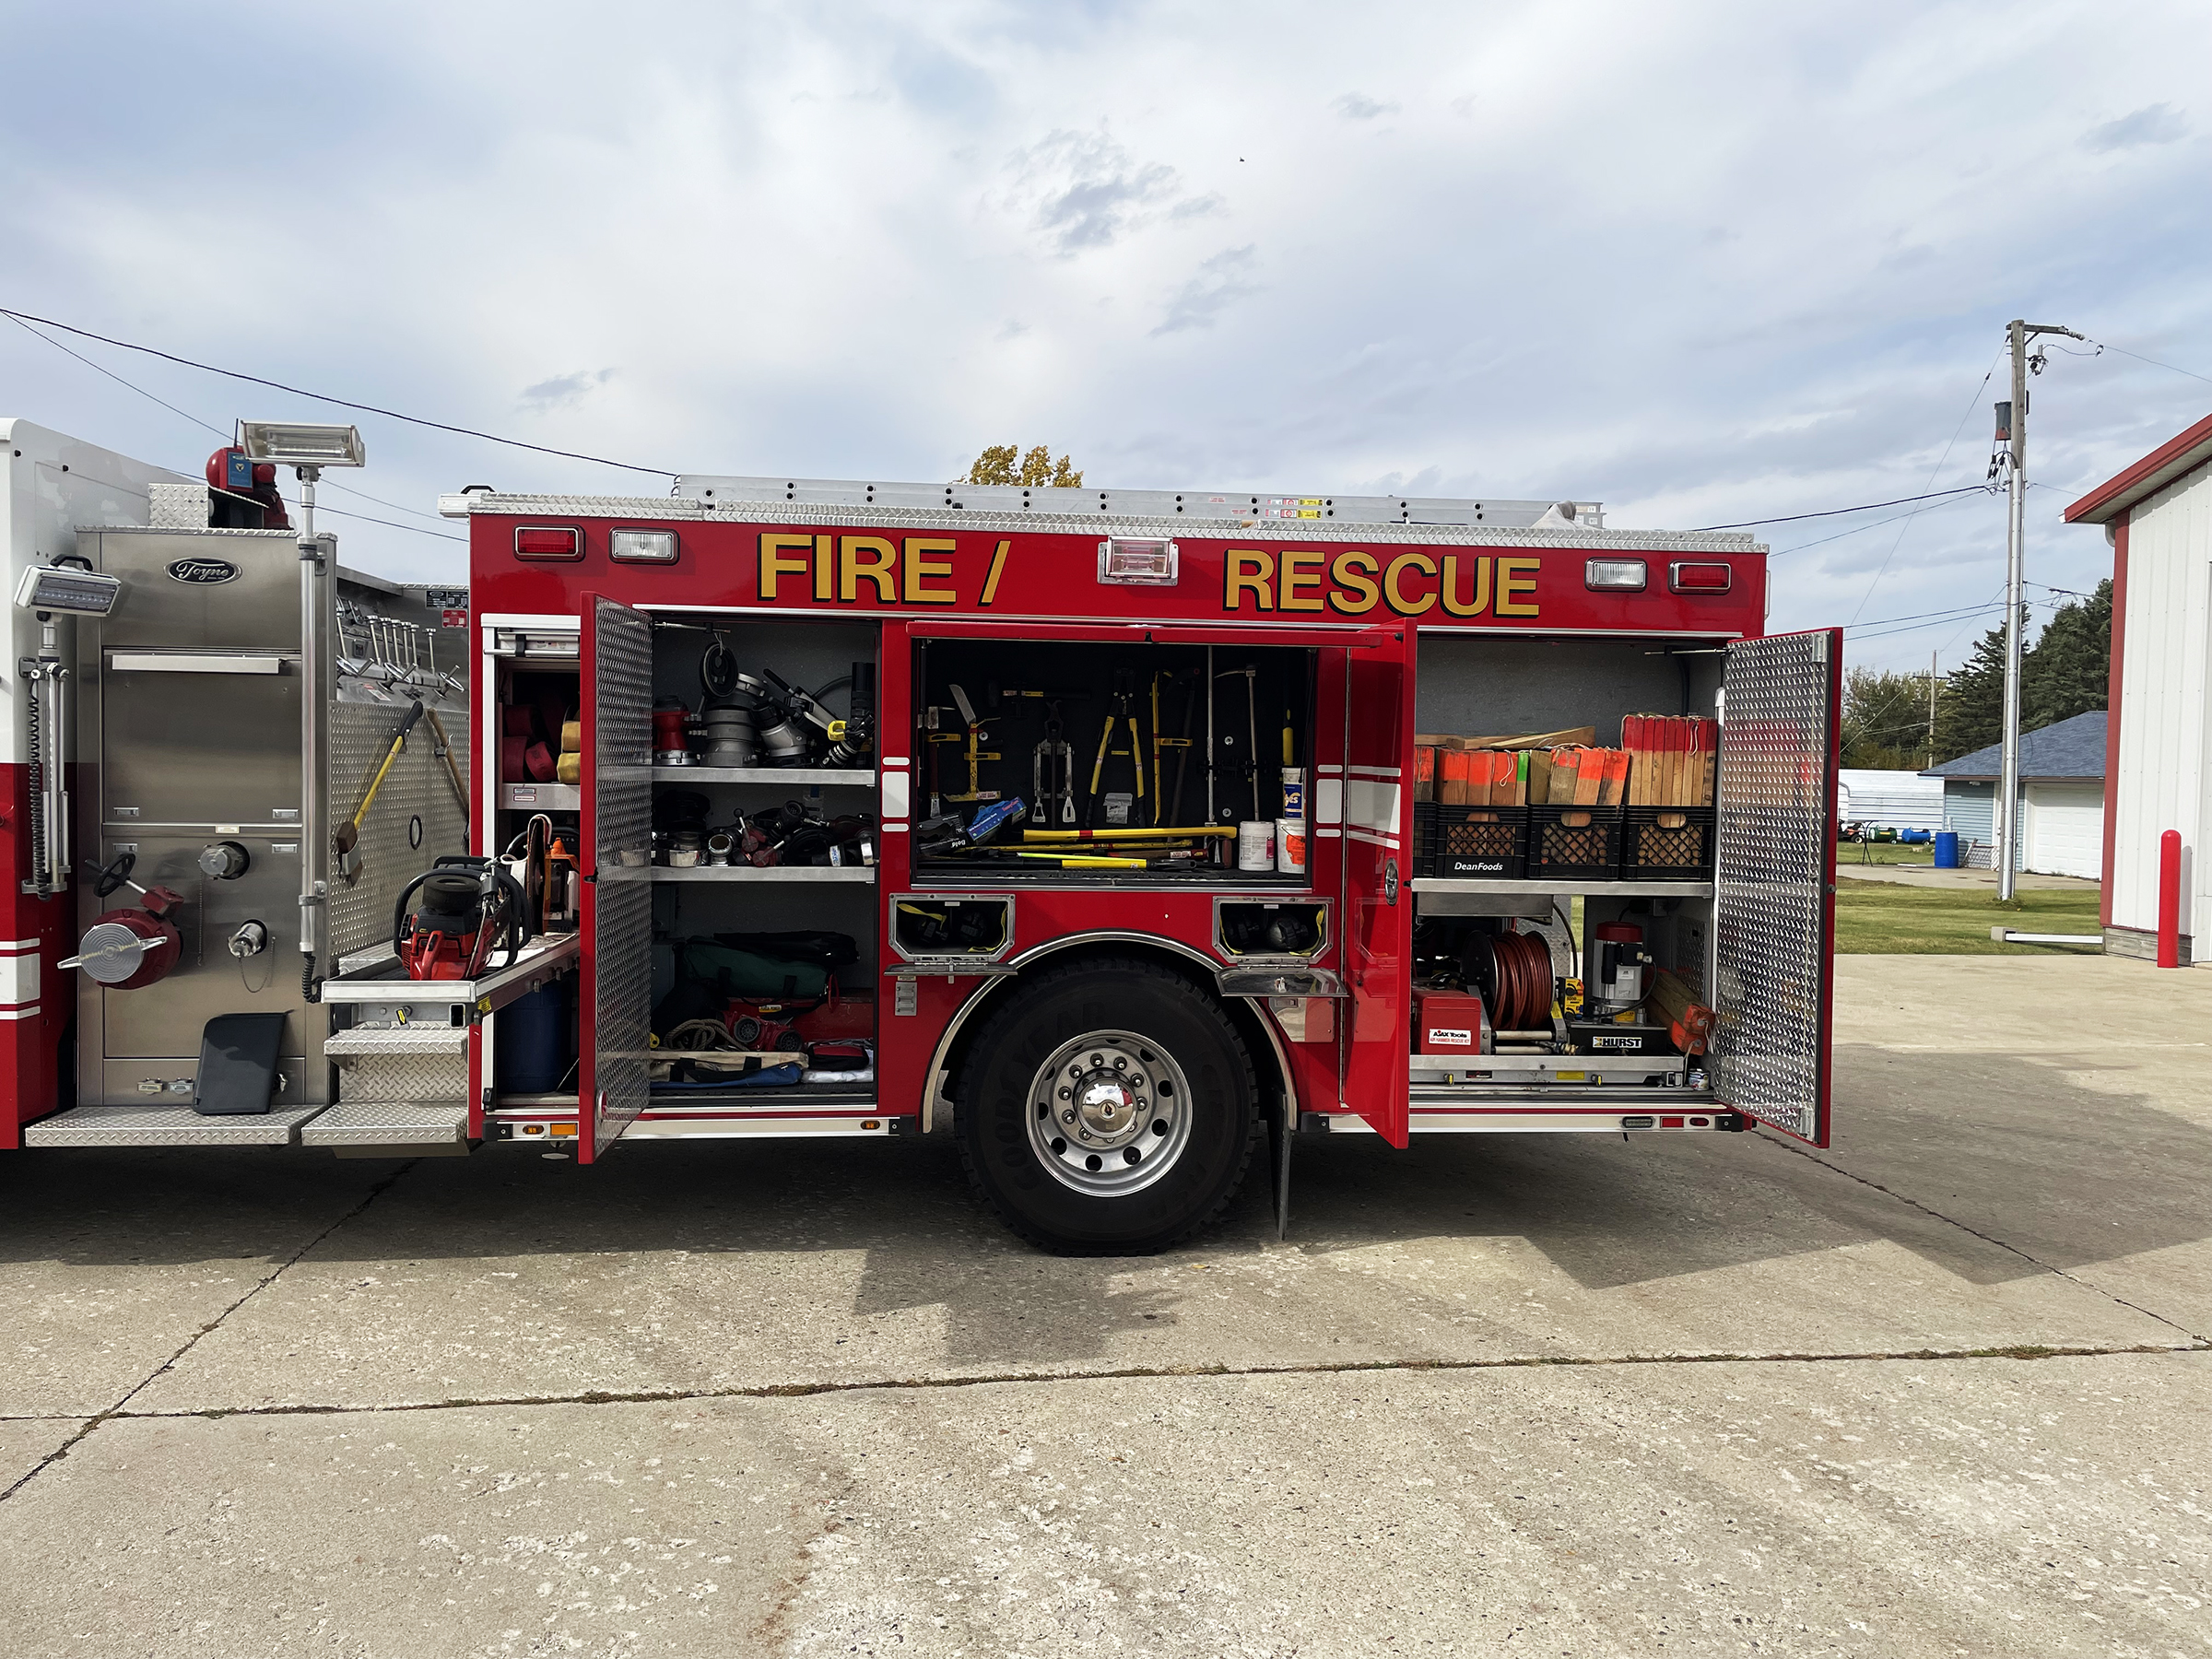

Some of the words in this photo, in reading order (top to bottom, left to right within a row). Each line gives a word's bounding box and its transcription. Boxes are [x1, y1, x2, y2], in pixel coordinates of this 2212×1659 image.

[176, 560, 229, 581] Toyne
[757, 533, 957, 606] FIRE
[977, 539, 1011, 606] /
[1222, 548, 1541, 618] RESCUE
[1453, 861, 1503, 871] DeanFoods
[1602, 1037, 1641, 1047] HURST
